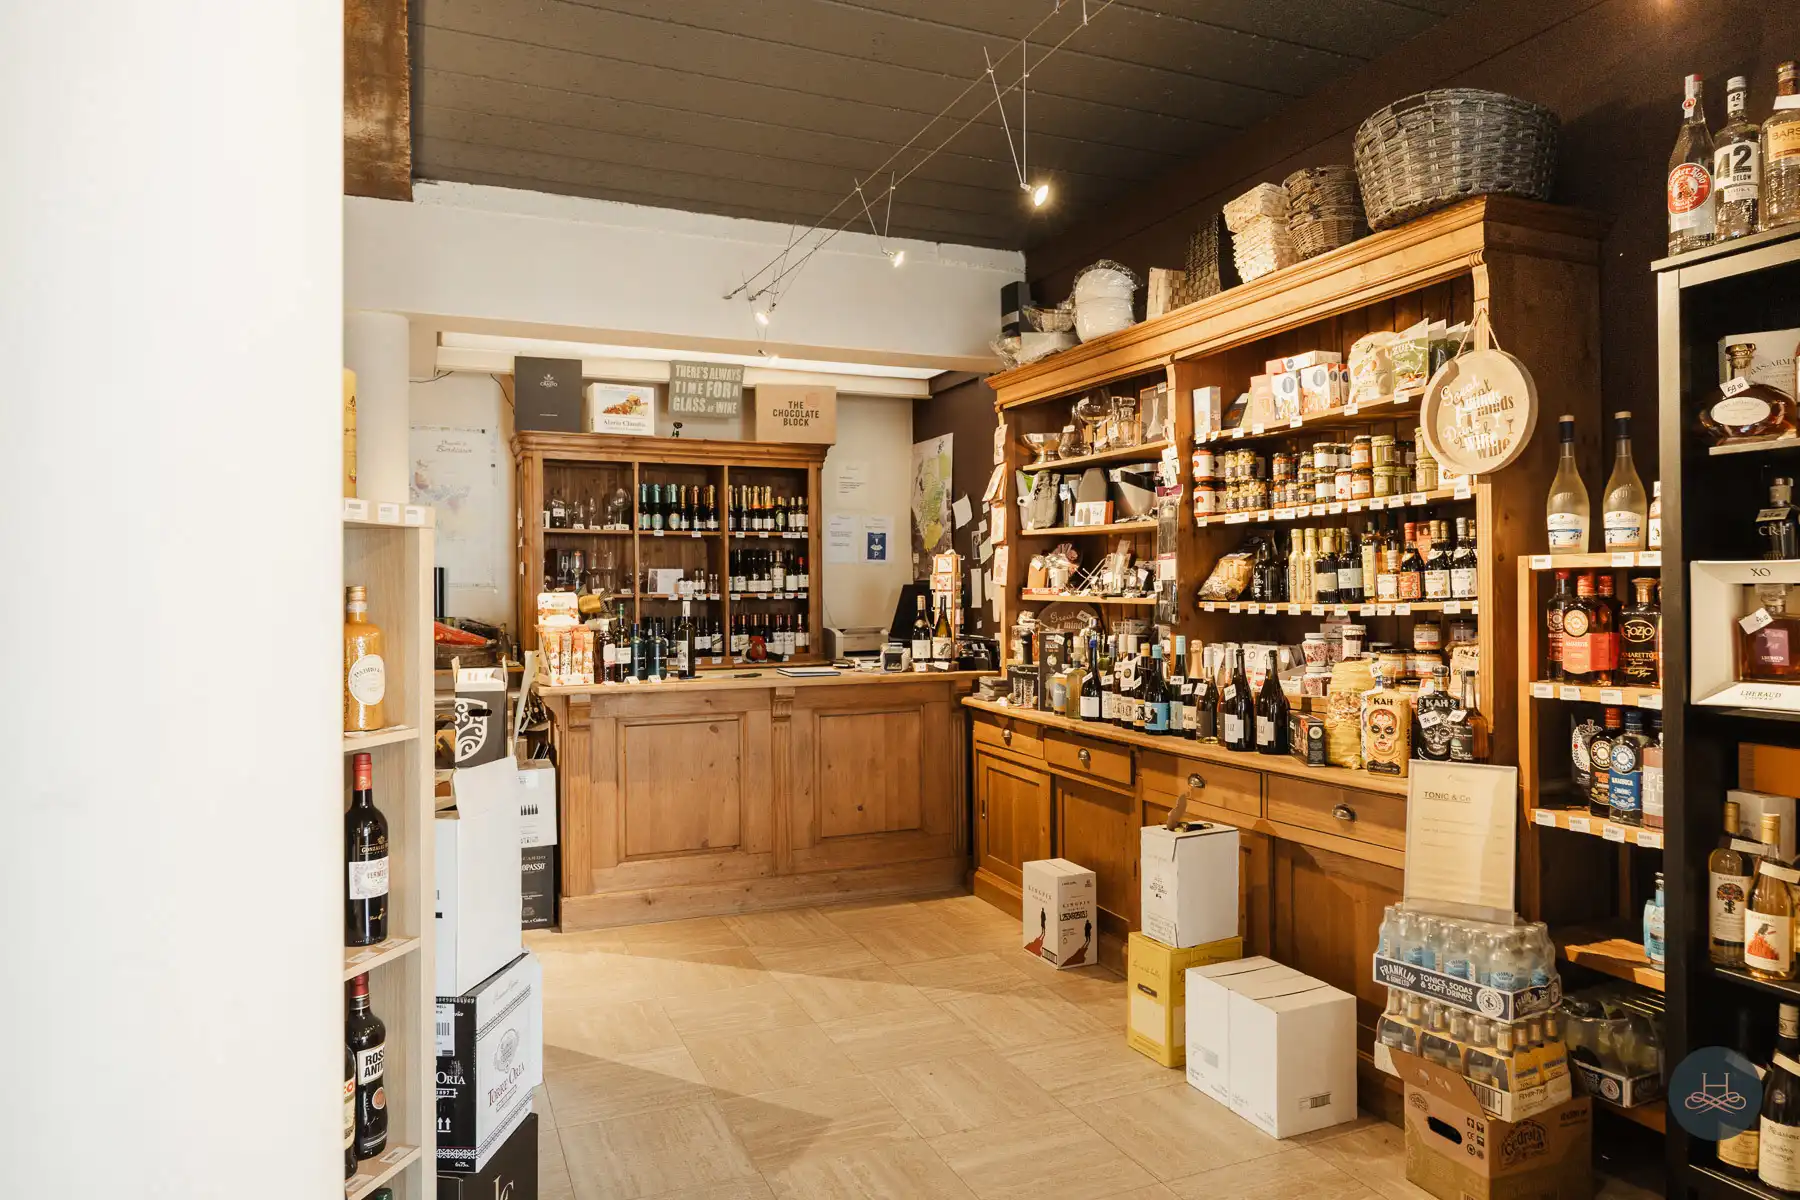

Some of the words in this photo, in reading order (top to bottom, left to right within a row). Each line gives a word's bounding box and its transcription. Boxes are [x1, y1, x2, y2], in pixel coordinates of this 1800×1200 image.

[1716, 145, 1752, 179] 42
[676, 364, 709, 380] THERE'S
[709, 366, 742, 381] ALWAYS
[674, 380, 705, 395] TIME
[705, 380, 732, 399] FOR
[732, 384, 739, 397] A
[673, 396, 706, 413] GLASS
[715, 401, 737, 414] WINE
[788, 400, 804, 410] THE
[772, 408, 820, 419] CHOCOLATE
[783, 417, 809, 427] BLOCK
[1750, 567, 1771, 577] XO
[1373, 697, 1394, 706] KAH
[1425, 698, 1449, 708] KAH
[1424, 791, 1449, 801] TONIC
[1451, 793, 1457, 801] &
[1379, 964, 1417, 985] FRANKLIN
[1419, 972, 1448, 989] TONICS,
[1449, 983, 1473, 995] SODAS
[1427, 982, 1445, 994] SOFT
[1446, 988, 1473, 1003] DRINKS
[436, 1071, 466, 1085] ORIA
